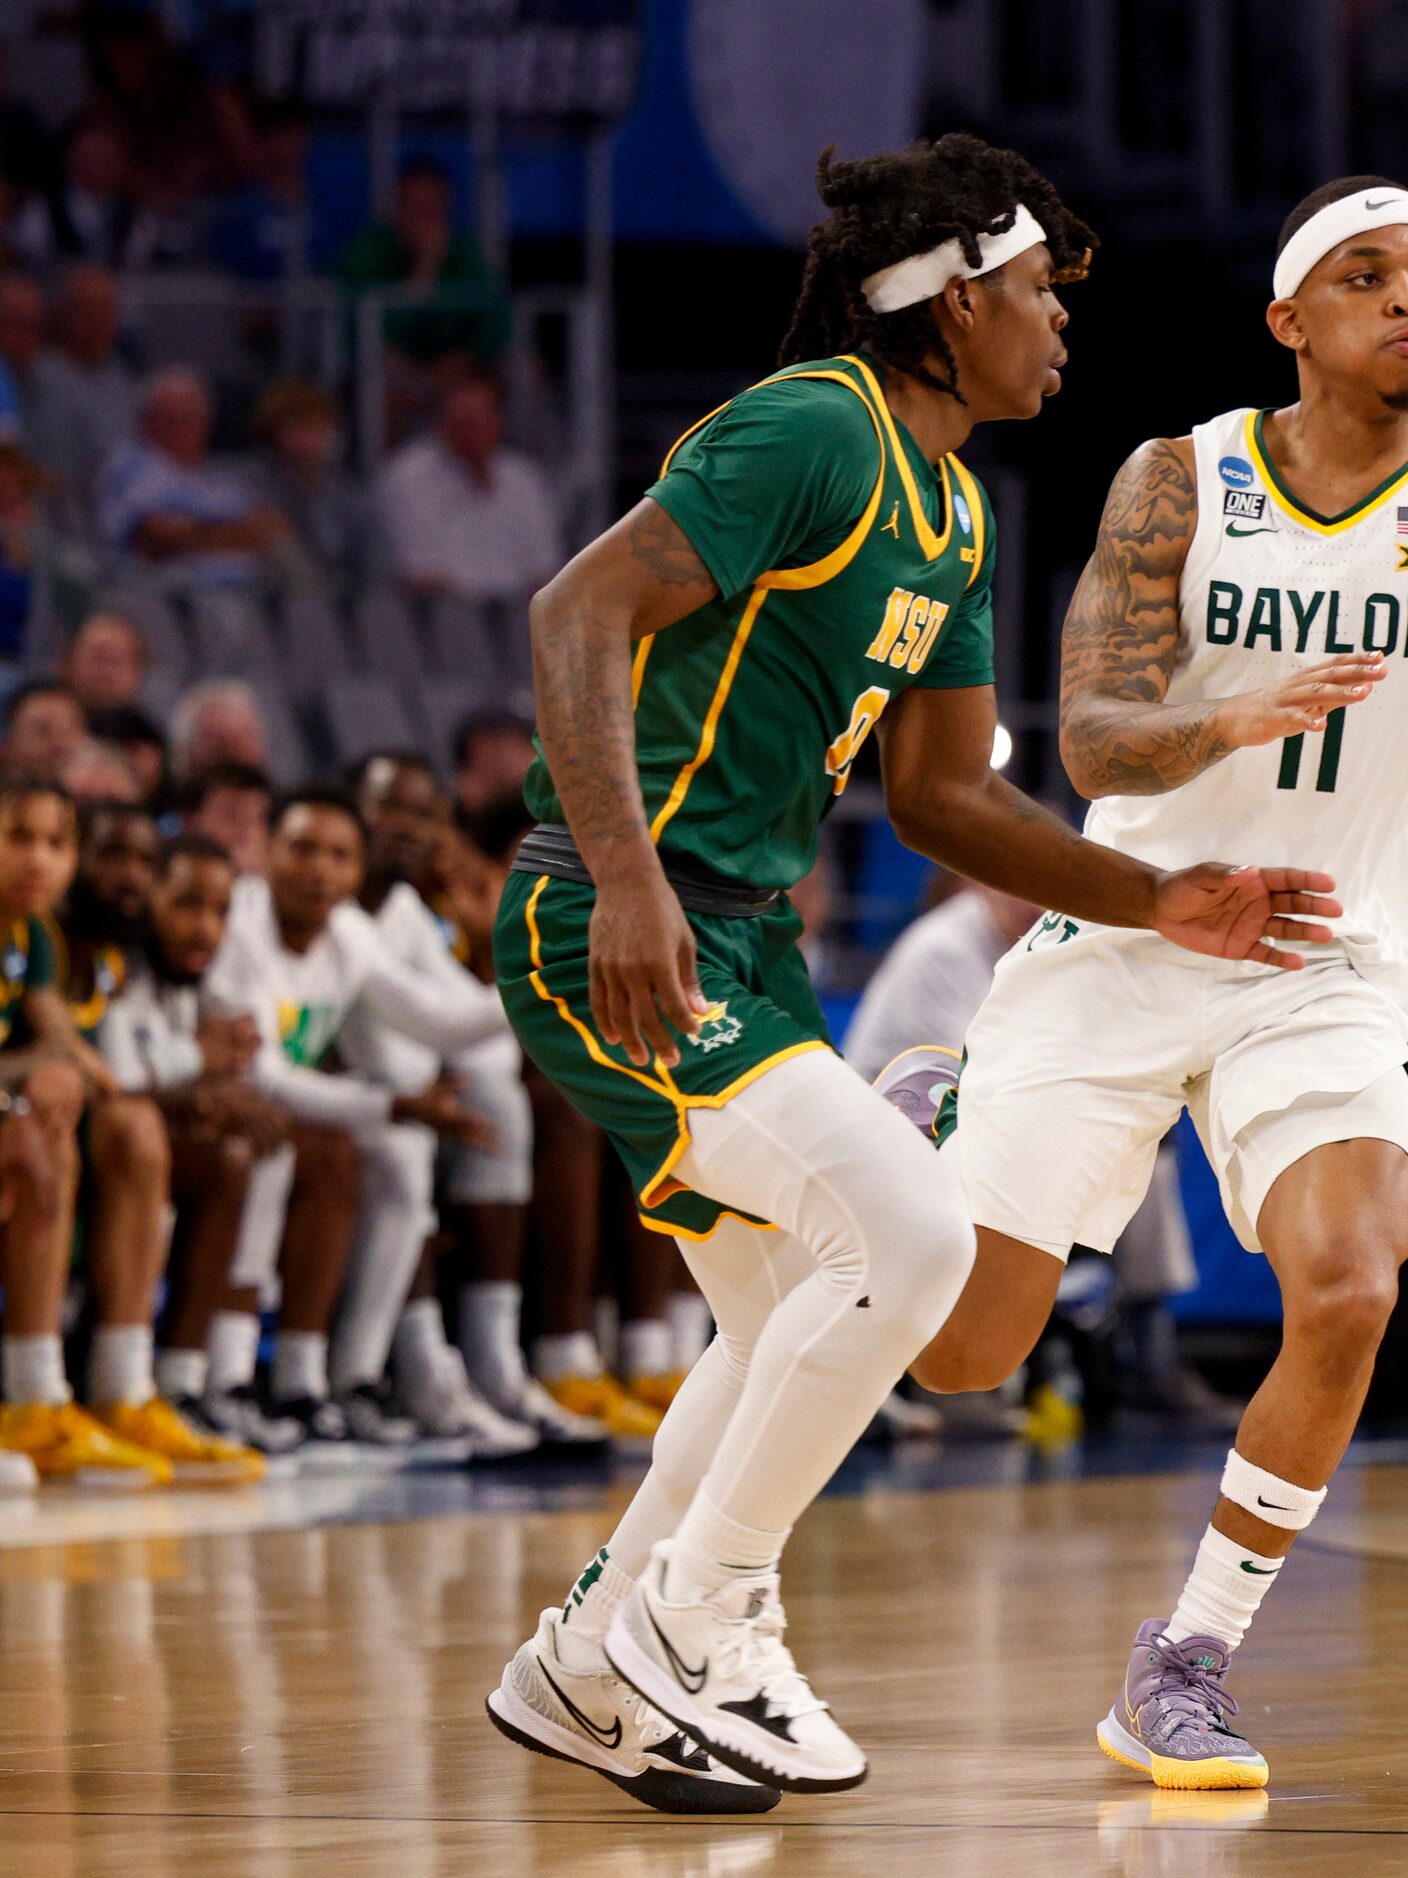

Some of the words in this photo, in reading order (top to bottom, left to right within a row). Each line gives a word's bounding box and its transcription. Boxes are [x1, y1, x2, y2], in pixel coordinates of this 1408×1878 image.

[1222, 467, 1252, 483] NCAA
[1228, 493, 1263, 513] ONE
[865, 587, 950, 674] NSU
